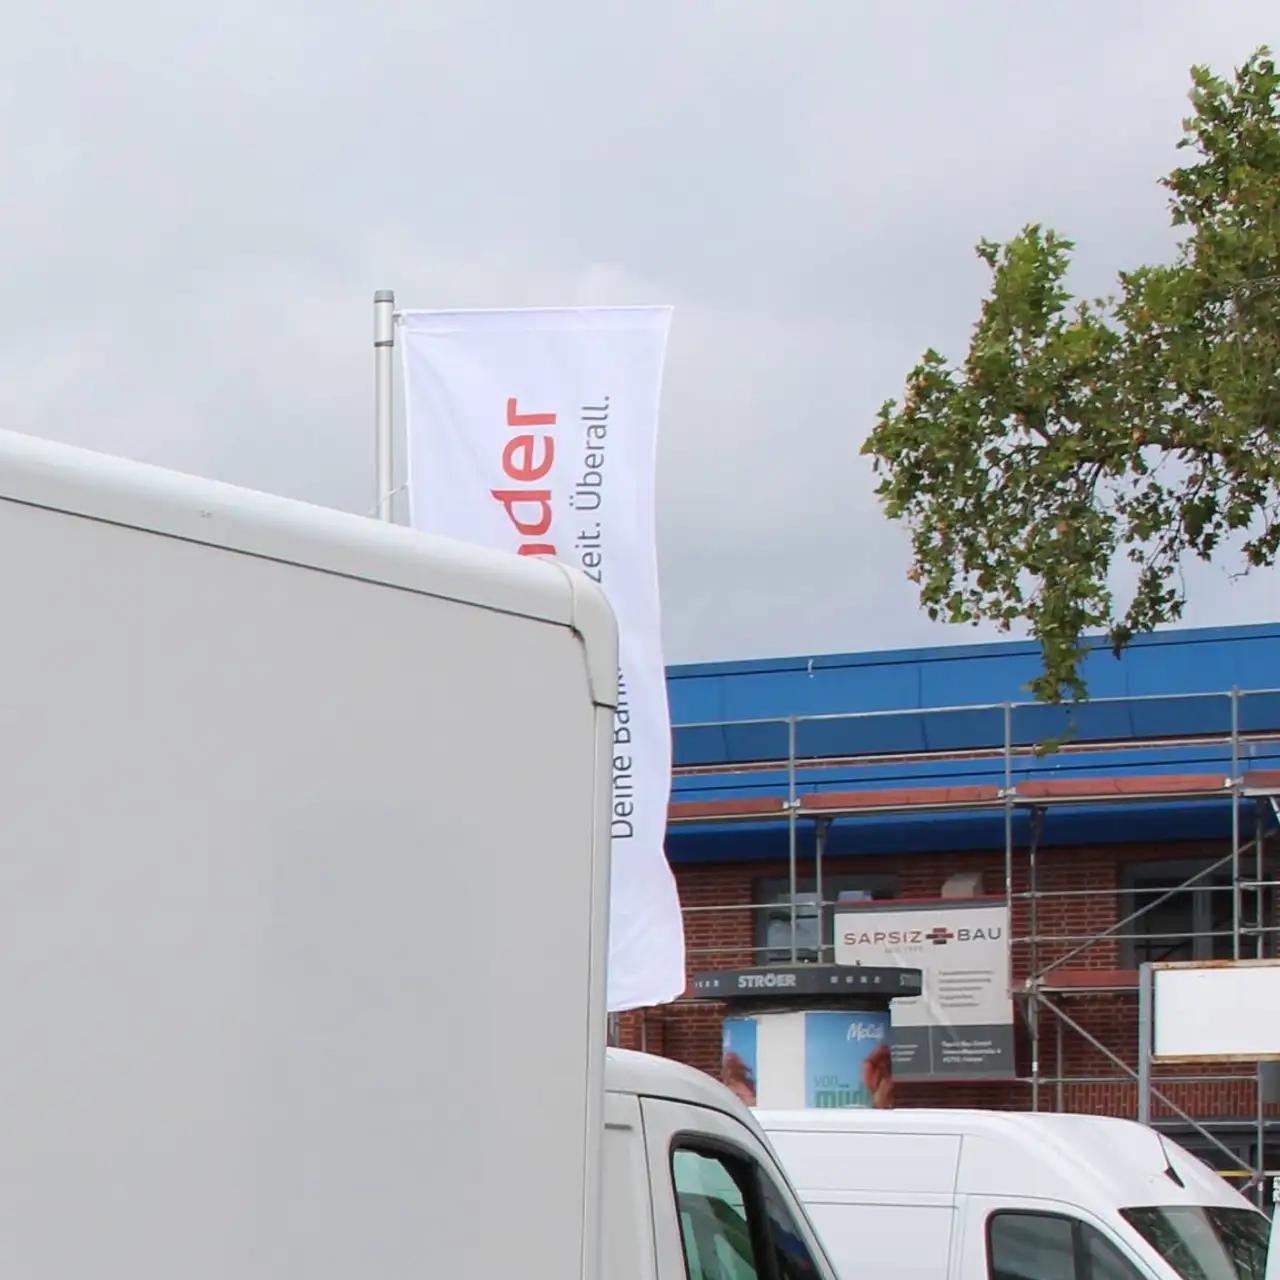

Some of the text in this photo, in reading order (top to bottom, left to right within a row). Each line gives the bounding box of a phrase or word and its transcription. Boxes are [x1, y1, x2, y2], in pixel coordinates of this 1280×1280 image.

[569, 396, 610, 510] Überall.
[611, 755, 634, 839] Deine
[844, 927, 1002, 946] SAPSIZ BAU
[738, 973, 796, 988] STRÖER
[814, 1075, 838, 1088] von
